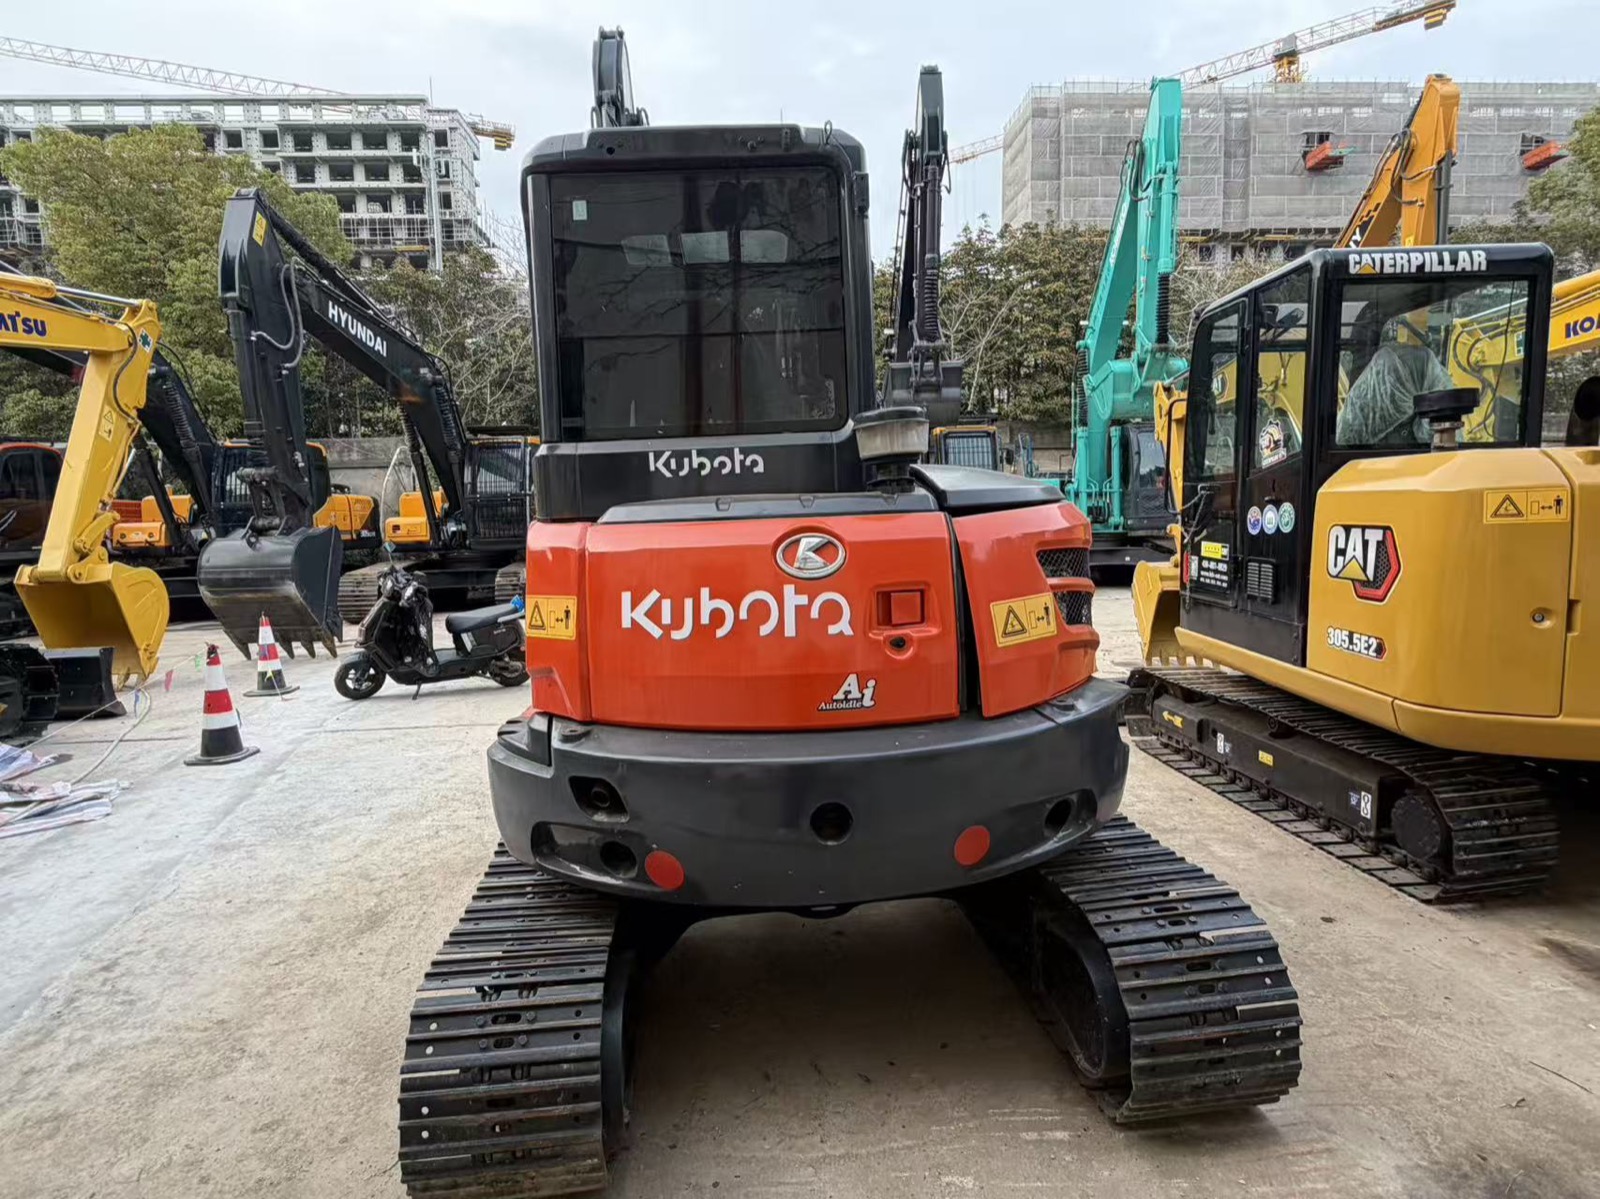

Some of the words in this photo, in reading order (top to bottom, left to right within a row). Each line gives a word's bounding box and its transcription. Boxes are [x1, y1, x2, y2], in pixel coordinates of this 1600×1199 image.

[1348, 250, 1488, 275] CATERPILLAR
[328, 299, 389, 357] HYUNDAI
[1565, 314, 1600, 339] KO
[649, 448, 764, 477] Kubota
[1328, 527, 1385, 580] CAT
[621, 584, 853, 640] Kubota
[1327, 626, 1378, 658] 305.5E2
